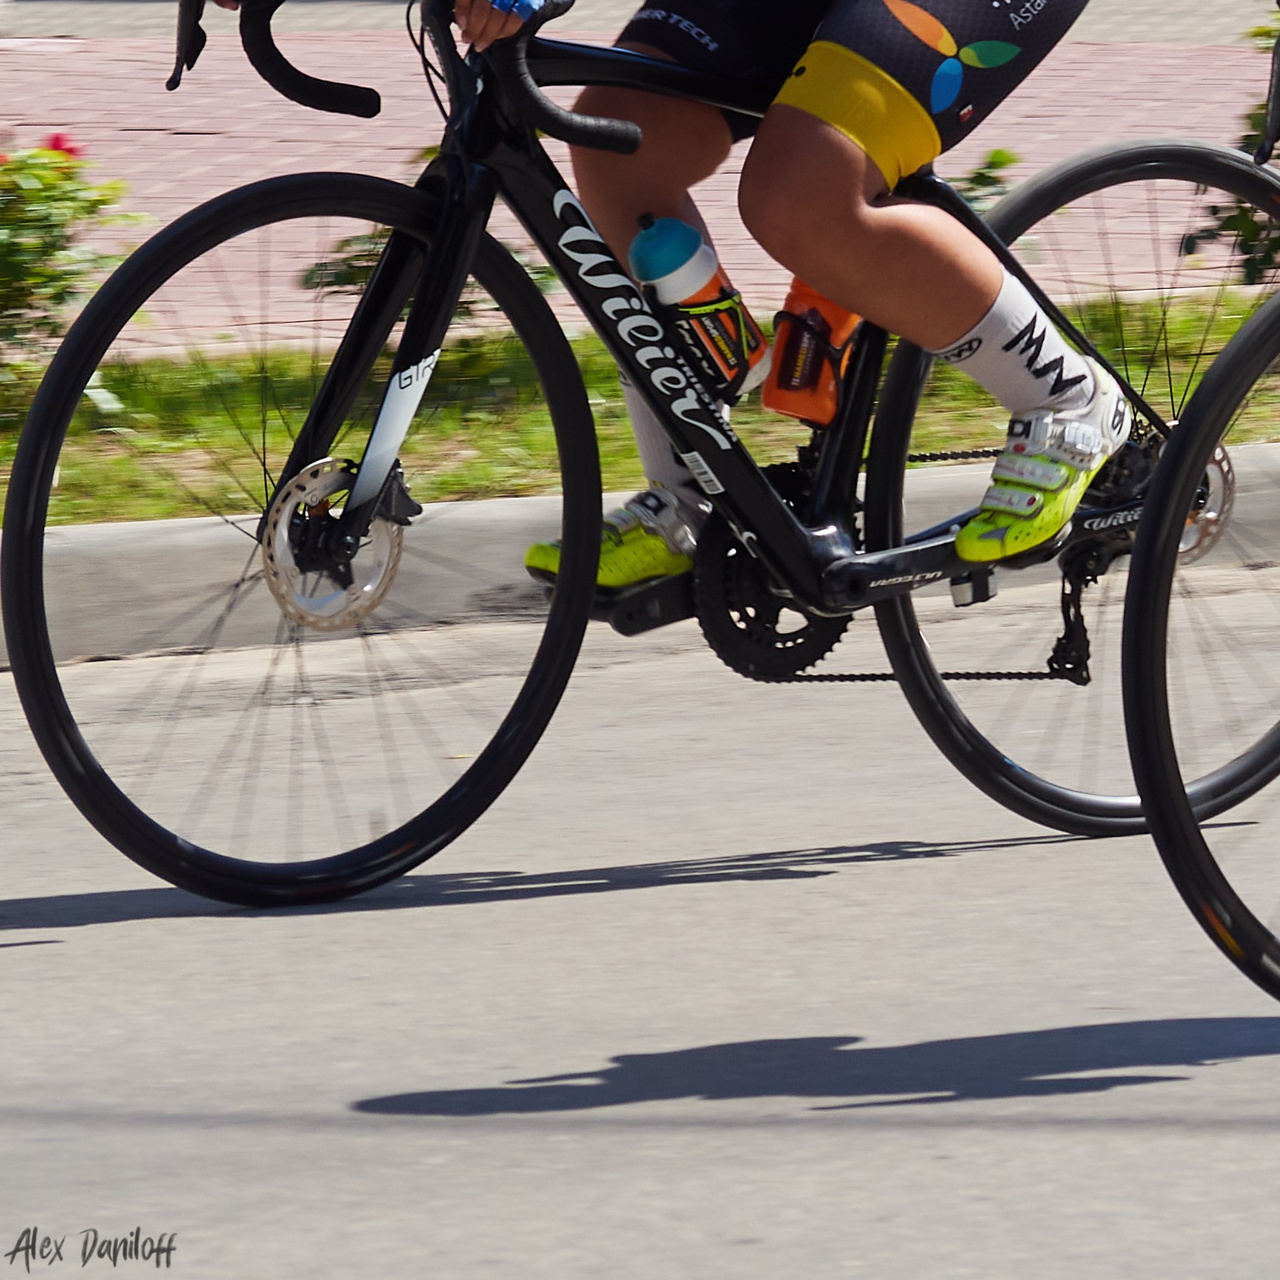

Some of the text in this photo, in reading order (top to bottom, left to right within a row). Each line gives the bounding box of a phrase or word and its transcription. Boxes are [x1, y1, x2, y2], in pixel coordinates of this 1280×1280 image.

[668, 12, 720, 52] TECH
[552, 188, 733, 451] Wilier
[869, 571, 943, 589] ULTEGRA
